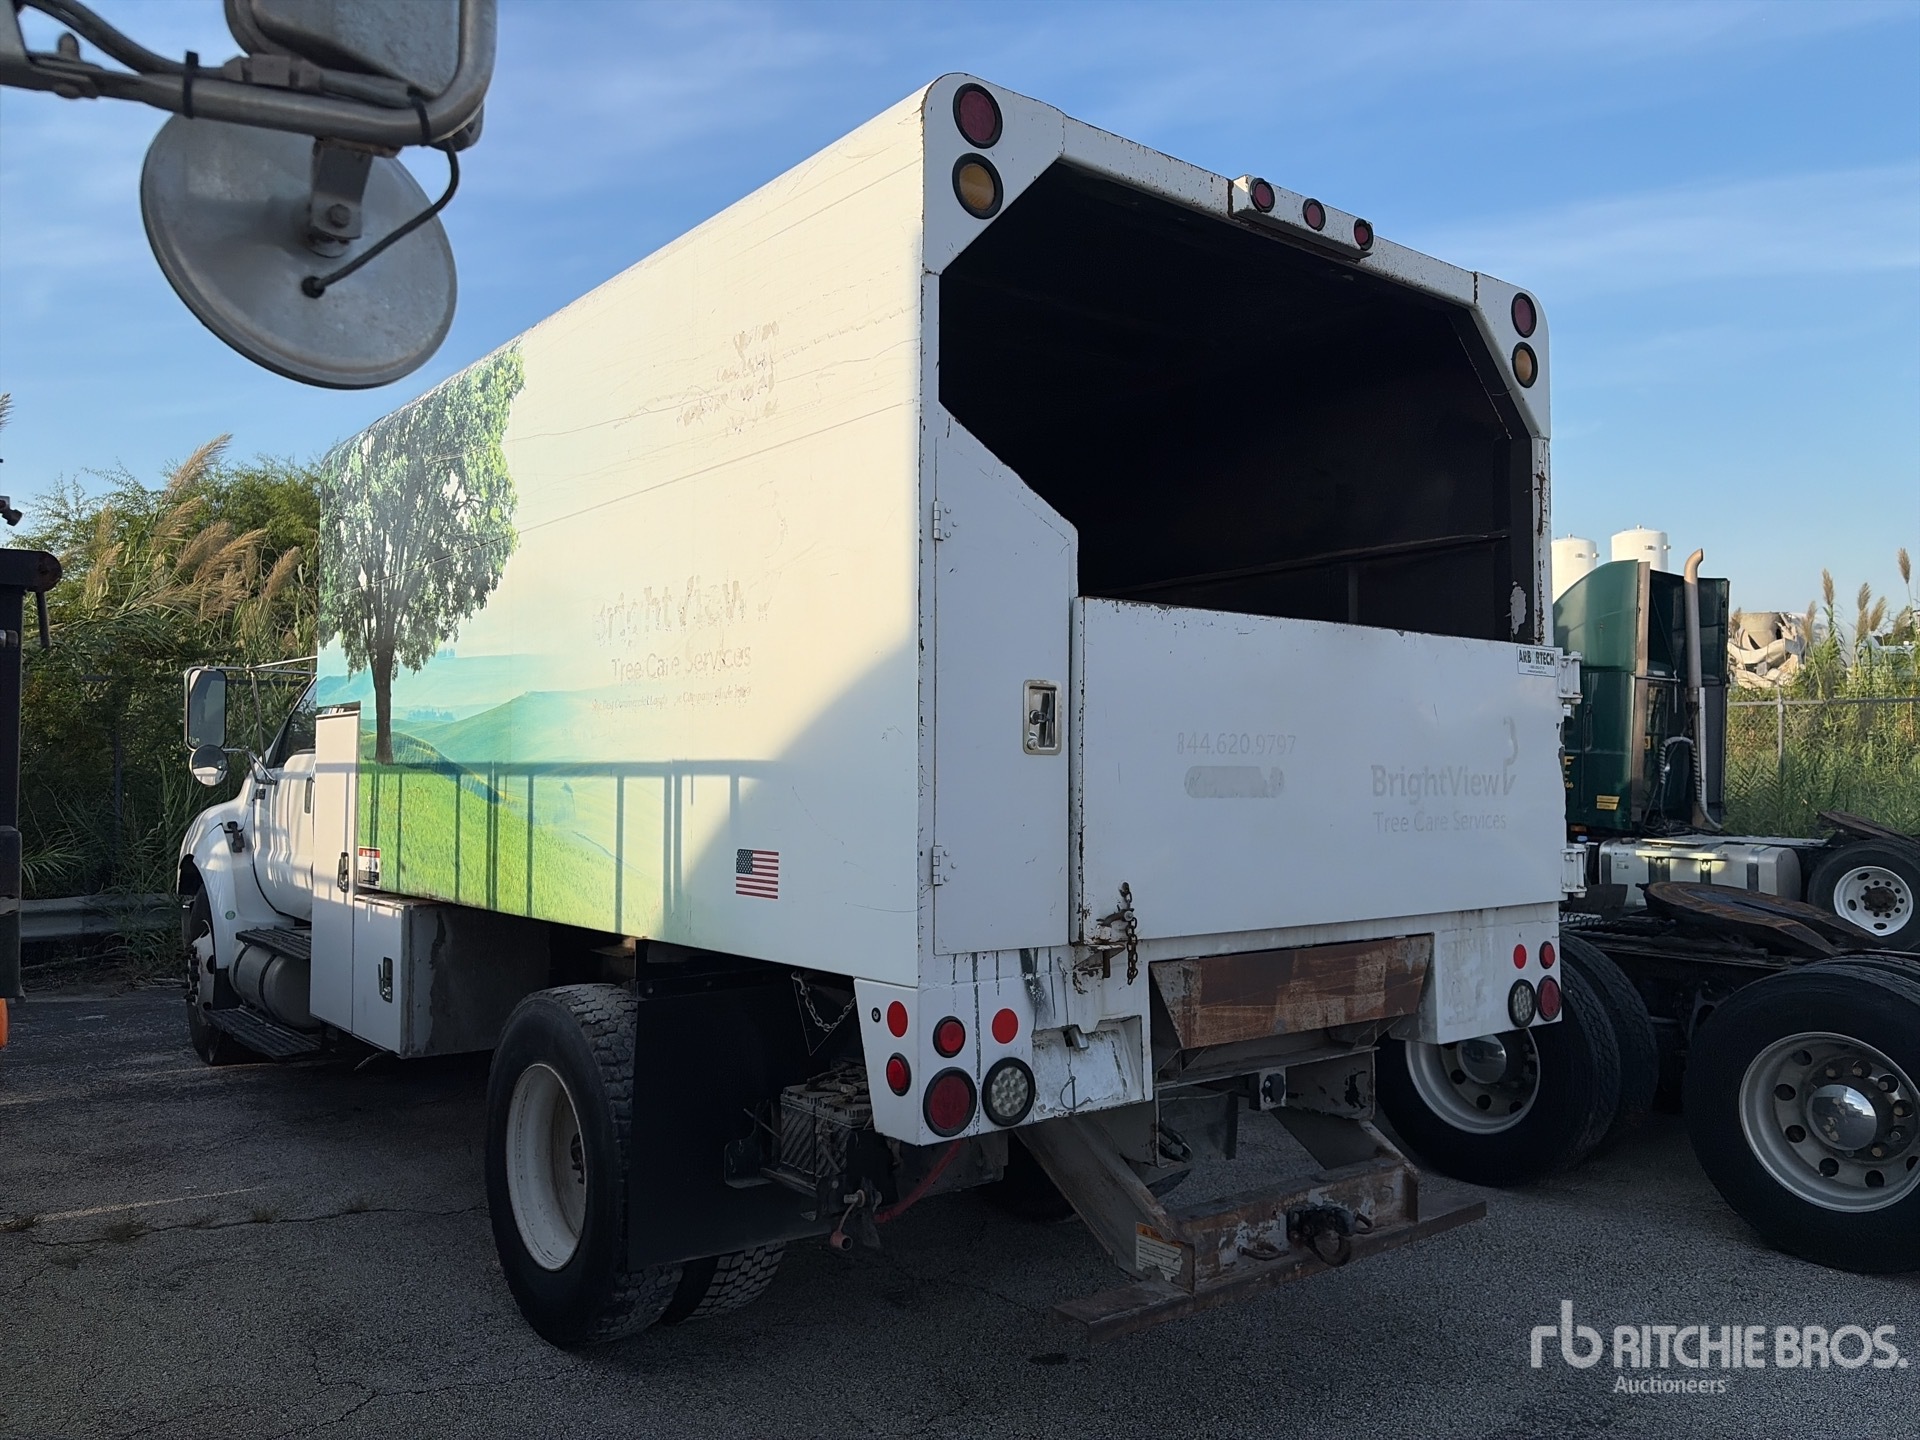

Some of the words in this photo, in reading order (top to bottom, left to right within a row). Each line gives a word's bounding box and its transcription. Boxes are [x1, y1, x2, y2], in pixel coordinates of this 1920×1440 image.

[612, 658, 642, 681] Tree
[1177, 732, 1296, 756] 844.620.9797
[1371, 764, 1503, 805] BrightView
[1374, 811, 1408, 834] Tree
[1413, 811, 1448, 833] Care
[1453, 810, 1507, 832] Services
